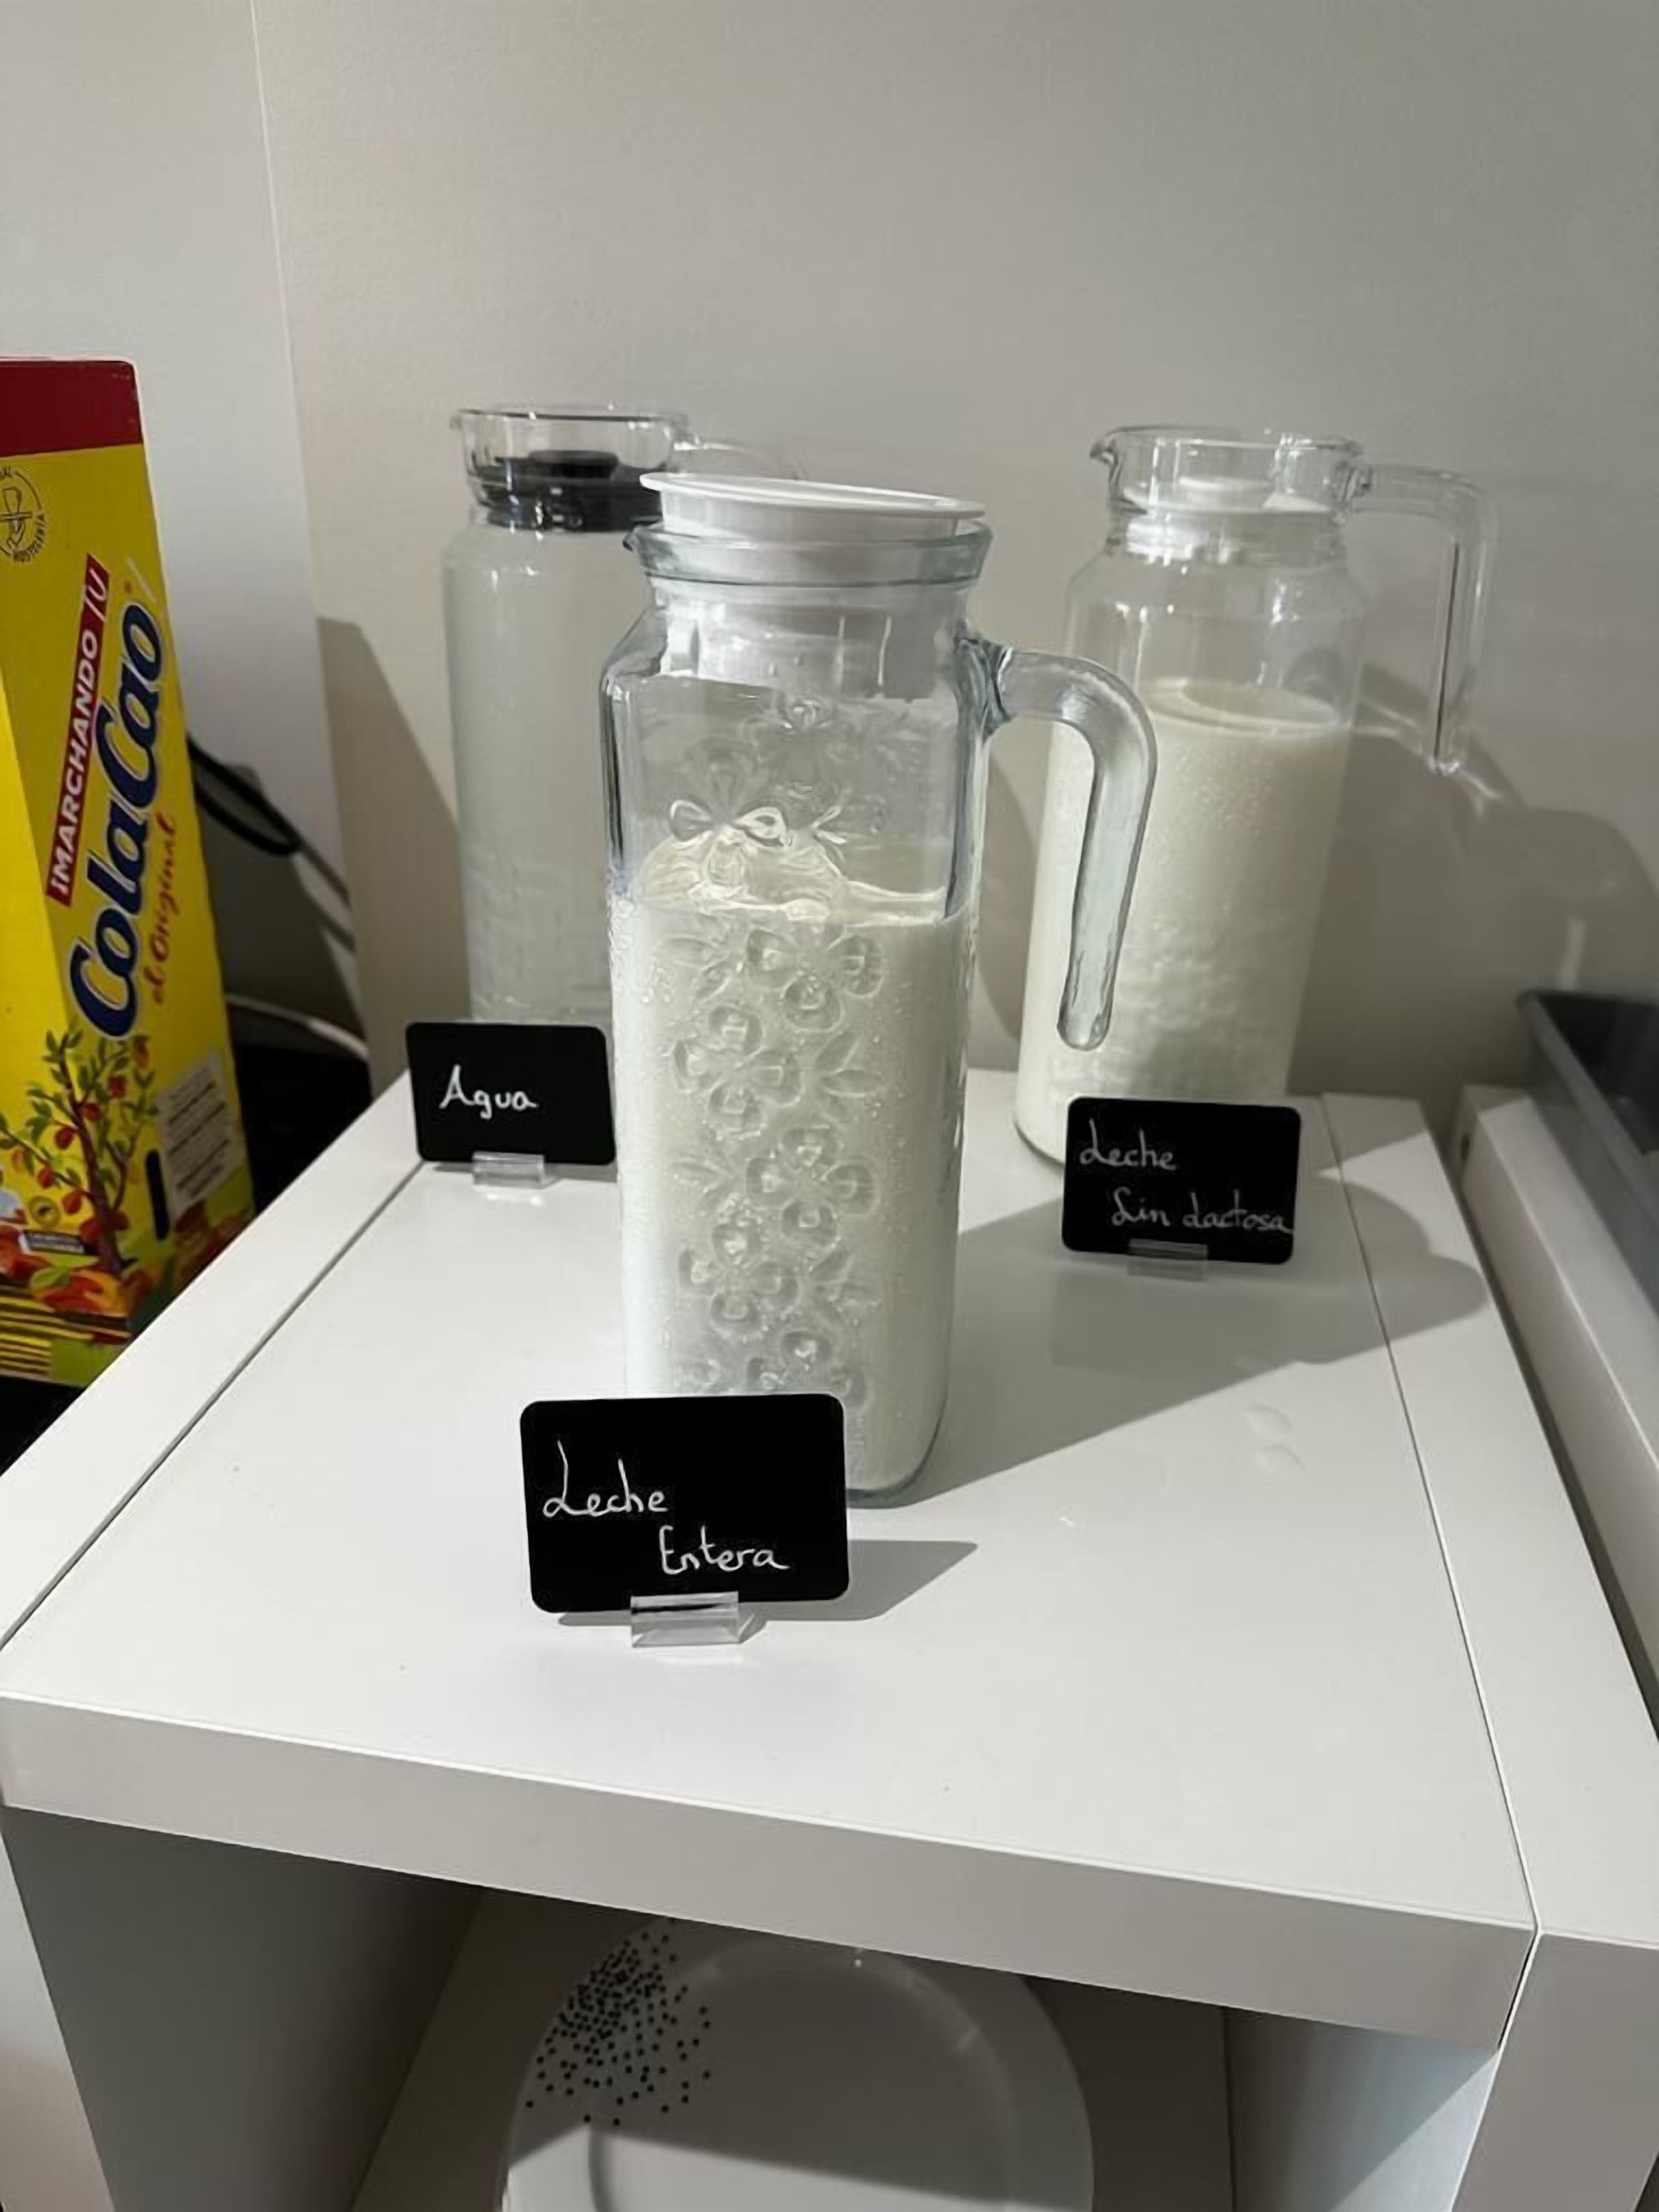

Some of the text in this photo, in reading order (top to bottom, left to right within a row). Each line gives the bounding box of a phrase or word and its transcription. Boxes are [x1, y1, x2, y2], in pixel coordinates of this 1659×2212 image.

[69, 603, 163, 1037] ColaCao
[439, 1064, 539, 1120] Agua
[1080, 1118, 1176, 1170] Leche
[1111, 1186, 1171, 1226] Sin
[543, 1440, 669, 1517] Leche
[659, 1525, 790, 1574] Entera
